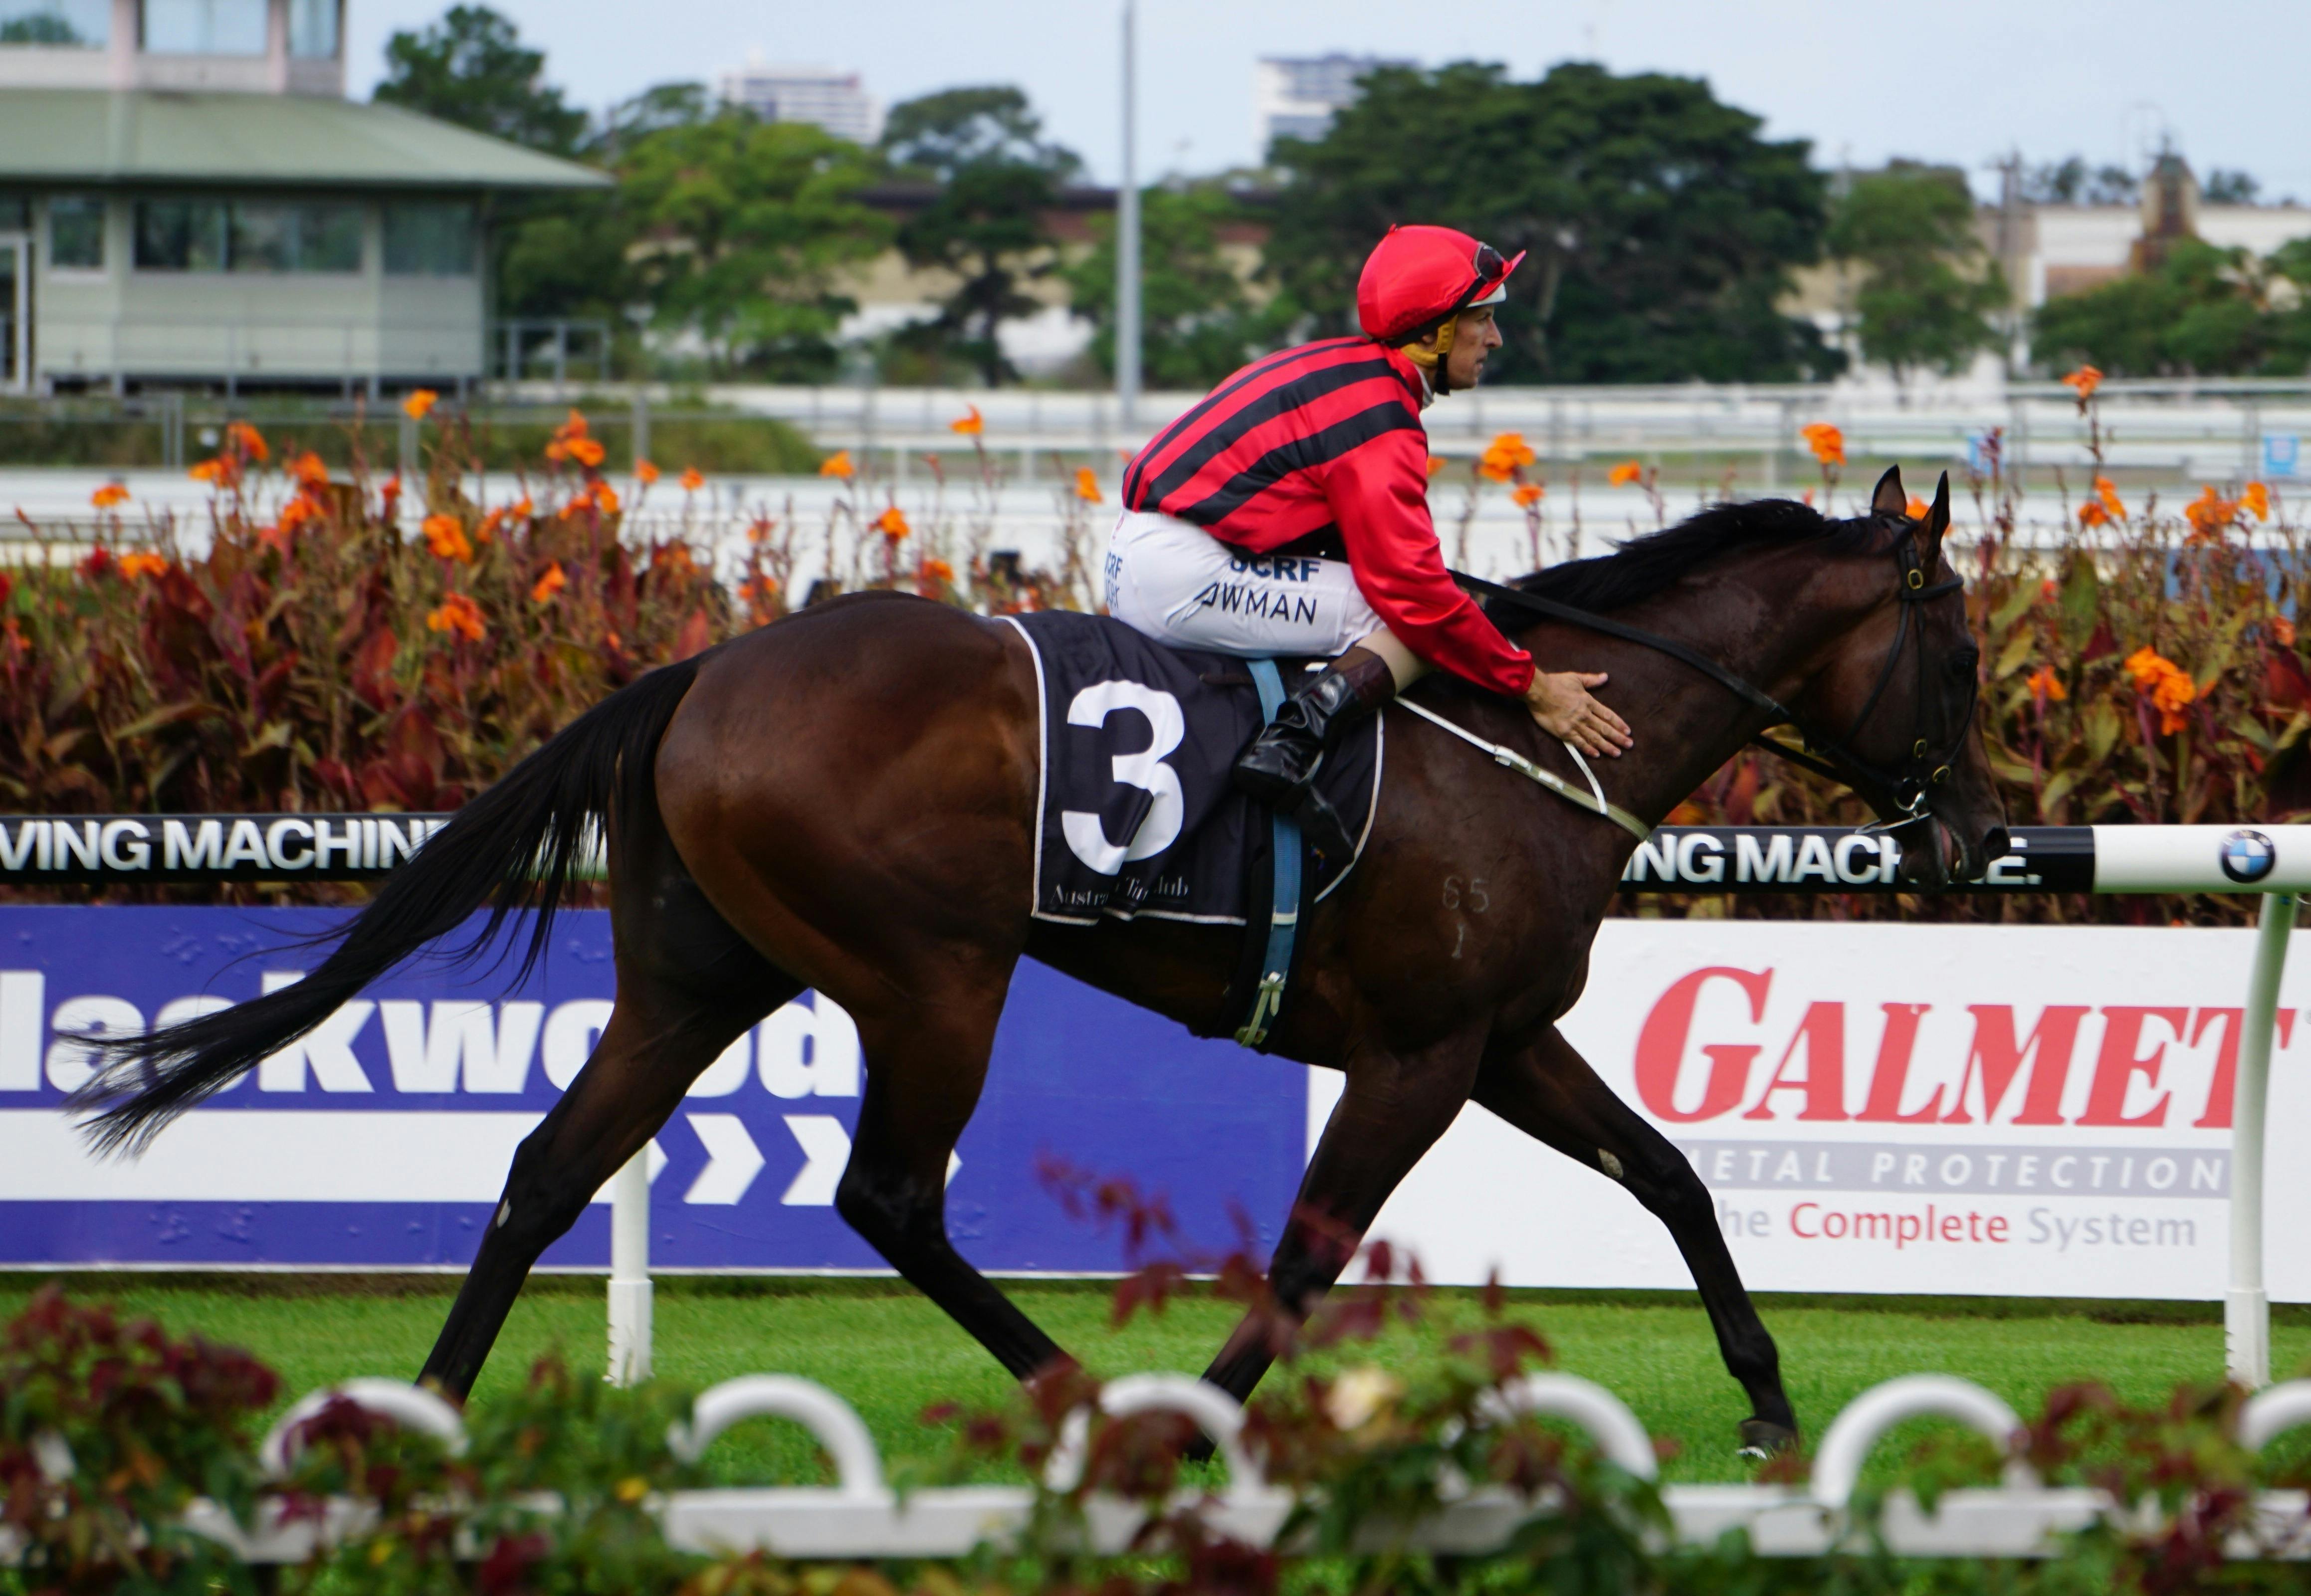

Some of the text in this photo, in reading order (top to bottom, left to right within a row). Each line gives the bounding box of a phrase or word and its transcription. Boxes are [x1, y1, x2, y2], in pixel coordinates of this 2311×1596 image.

[1061, 680, 1185, 876] 3
[163, 819, 451, 869] MACHIN
[1621, 833, 1725, 883] NG
[1634, 967, 2297, 1128] GALMET
[1872, 1153, 2222, 1191] PROTECTION
[1790, 1202, 2009, 1249] Complete
[2028, 1207, 2196, 1252] System
